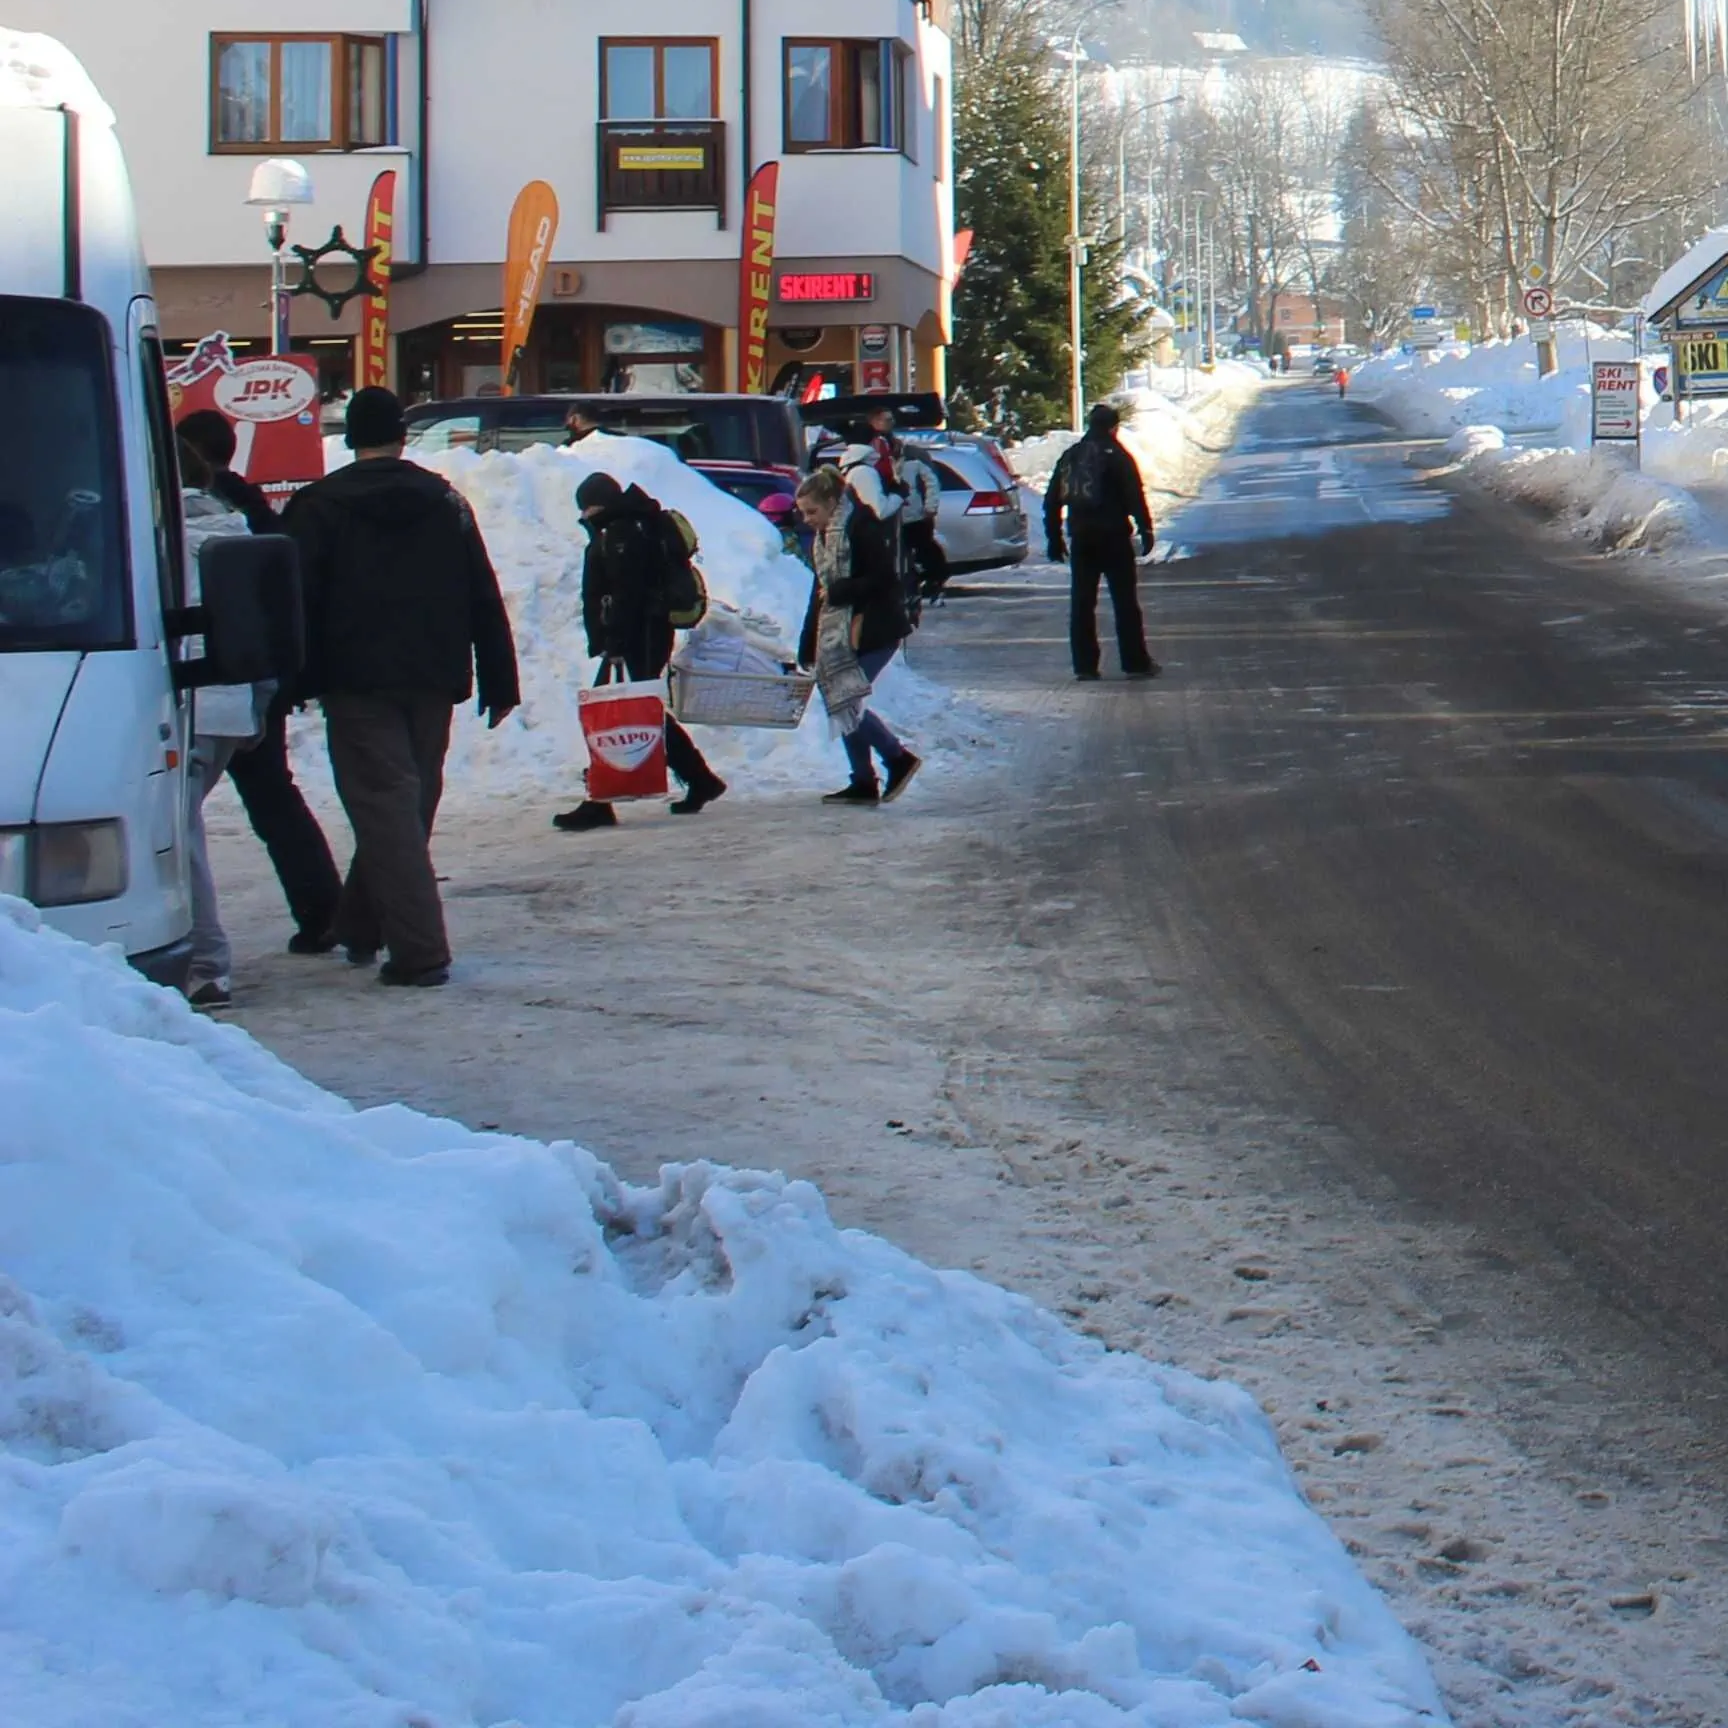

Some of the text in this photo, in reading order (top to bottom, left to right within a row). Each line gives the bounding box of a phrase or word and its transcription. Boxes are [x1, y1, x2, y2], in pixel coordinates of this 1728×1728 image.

[517, 215, 551, 326] HEAD
[780, 274, 857, 301] SKIRENT
[1682, 341, 1719, 372] SKI
[1595, 380, 1637, 392] RENT
[1596, 367, 1622, 380] SKI
[232, 377, 294, 403] JPK
